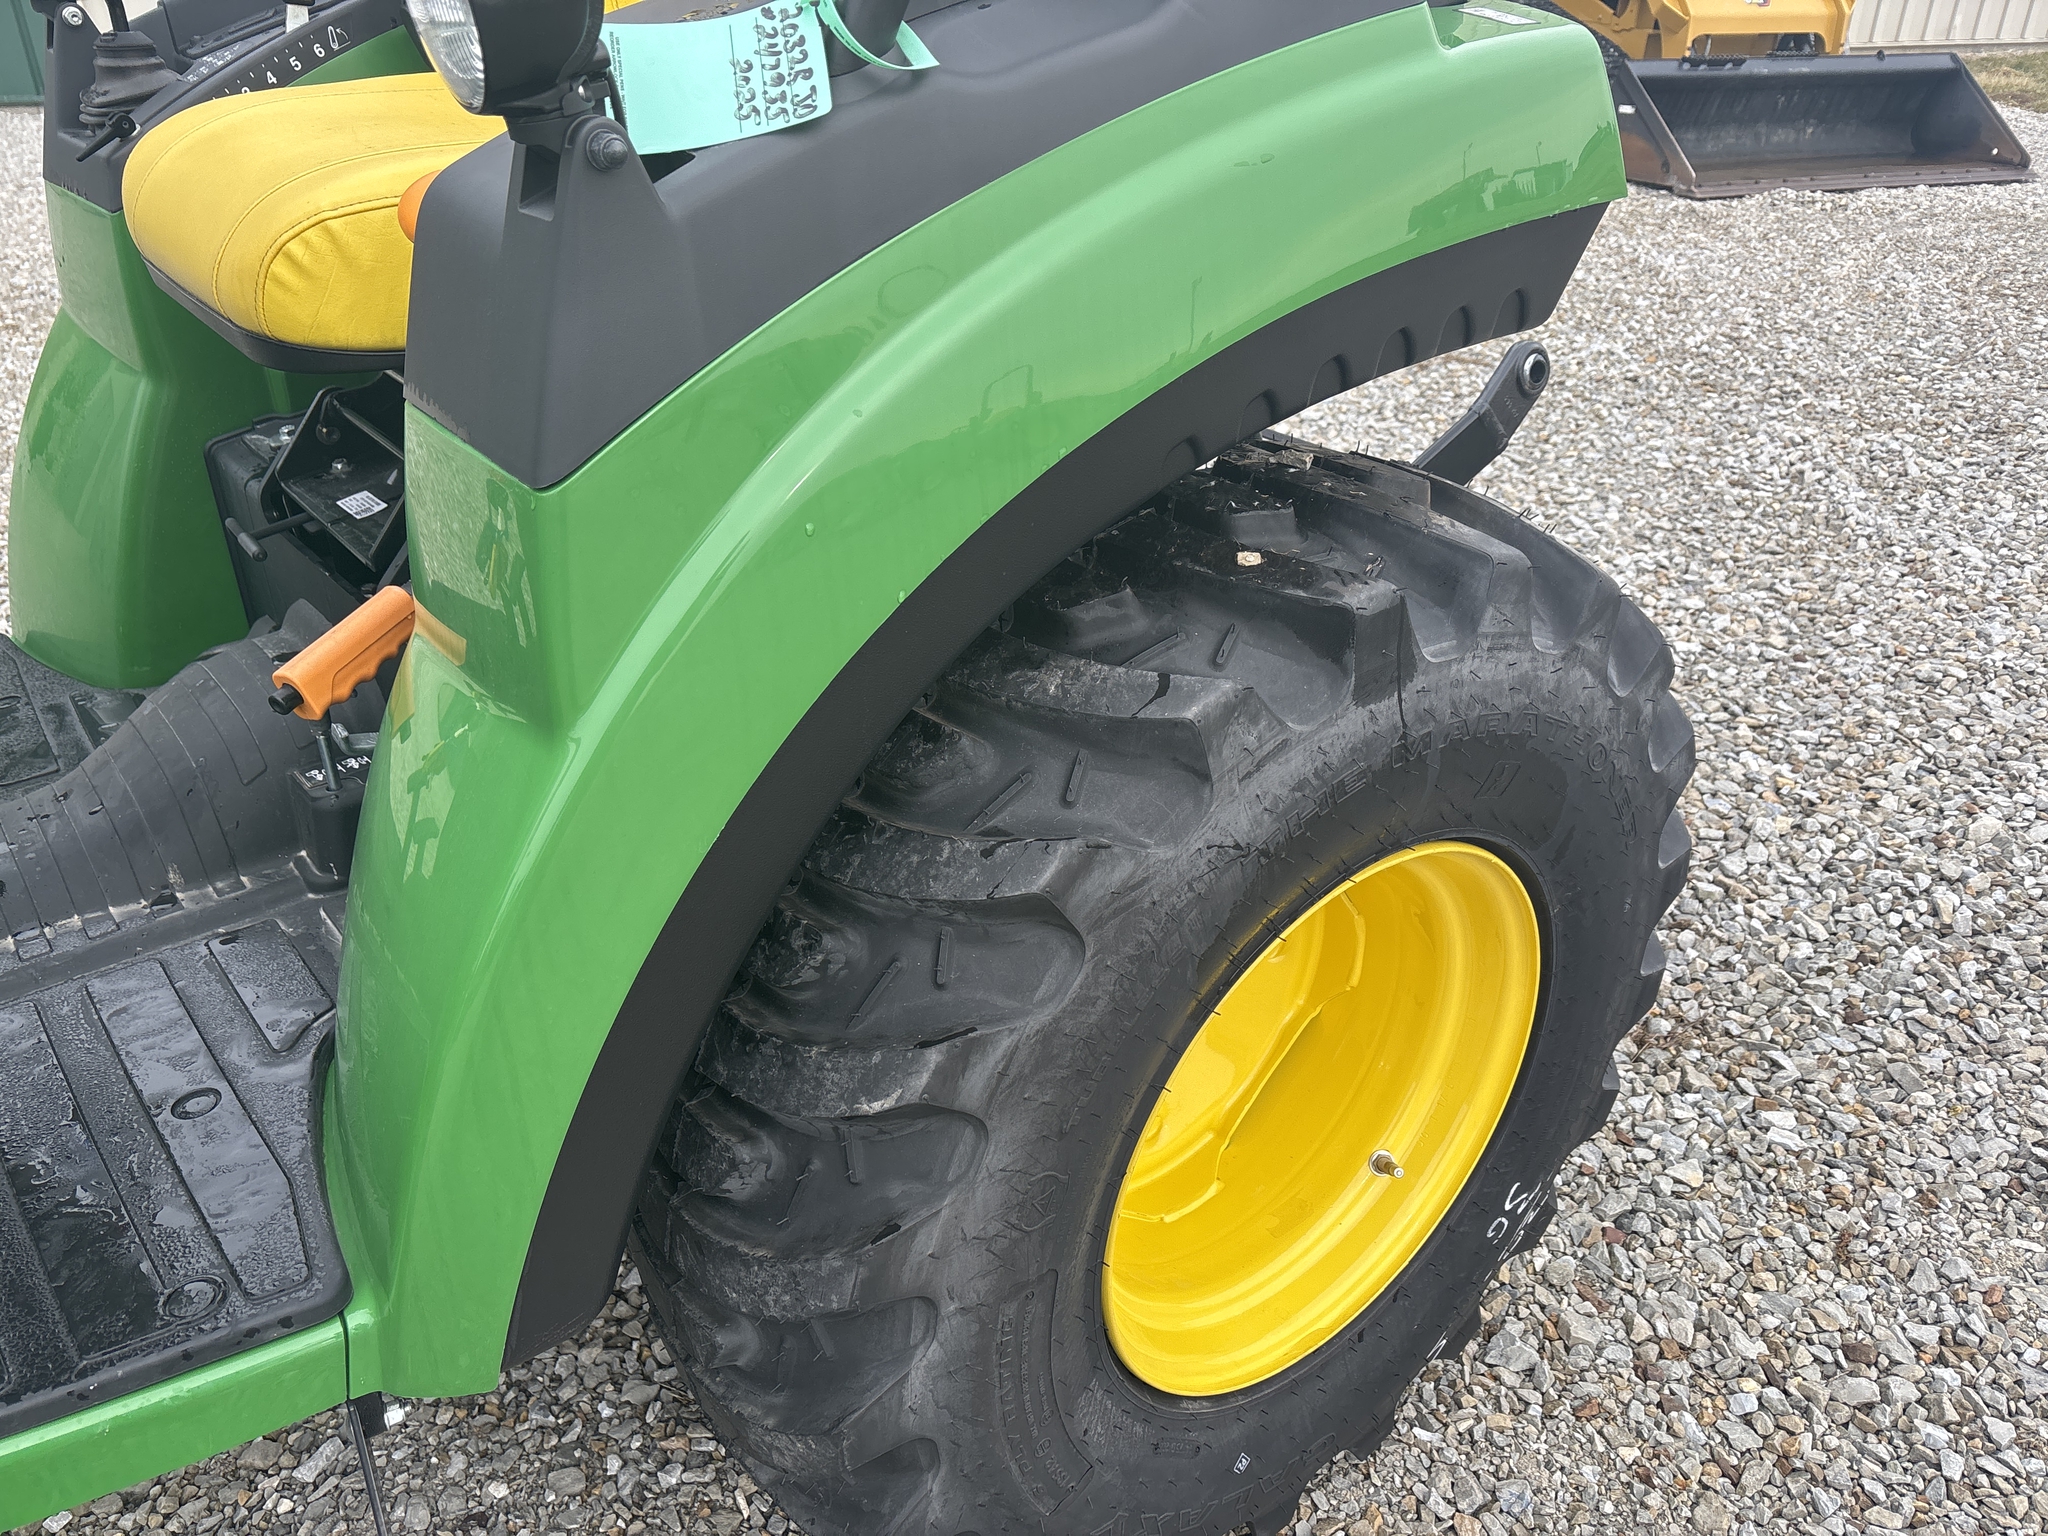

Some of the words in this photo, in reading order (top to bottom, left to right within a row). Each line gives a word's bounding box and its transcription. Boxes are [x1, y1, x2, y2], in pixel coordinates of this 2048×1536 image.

[266, 70, 278, 85] 4
[289, 56, 302, 71] 5
[313, 43, 325, 58] 6
[778, 2, 814, 86] 2032R
[728, 58, 761, 126] 2025
